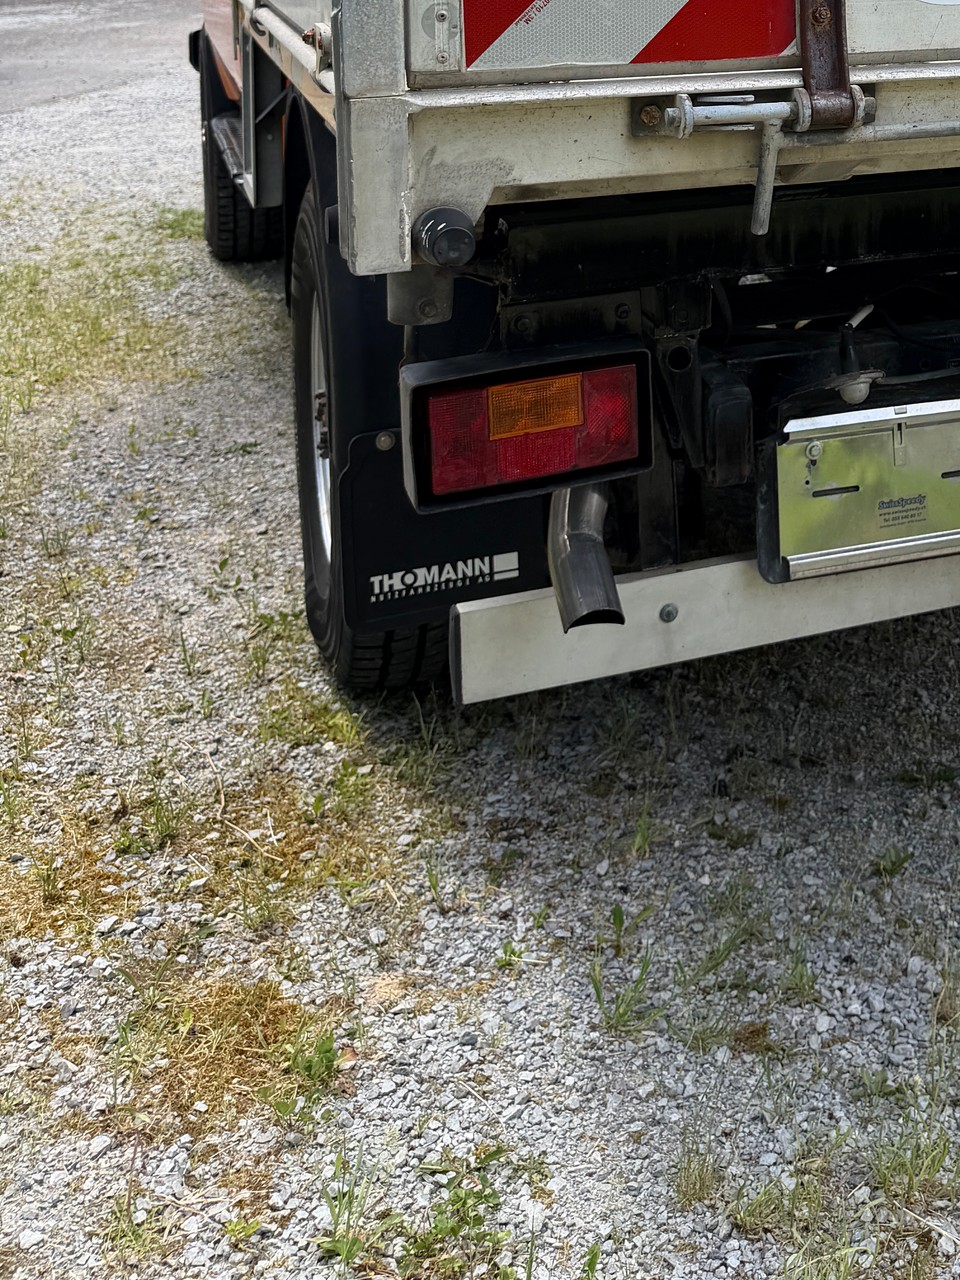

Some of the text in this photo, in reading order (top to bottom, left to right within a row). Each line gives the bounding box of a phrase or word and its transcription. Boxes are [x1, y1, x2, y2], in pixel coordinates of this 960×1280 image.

[523, 14, 535, 25] 3M
[878, 494, 926, 510] SwissSpeedy
[369, 556, 490, 595] THOMANN
[370, 575, 491, 603] NUTZFAHRZEUGE AG
